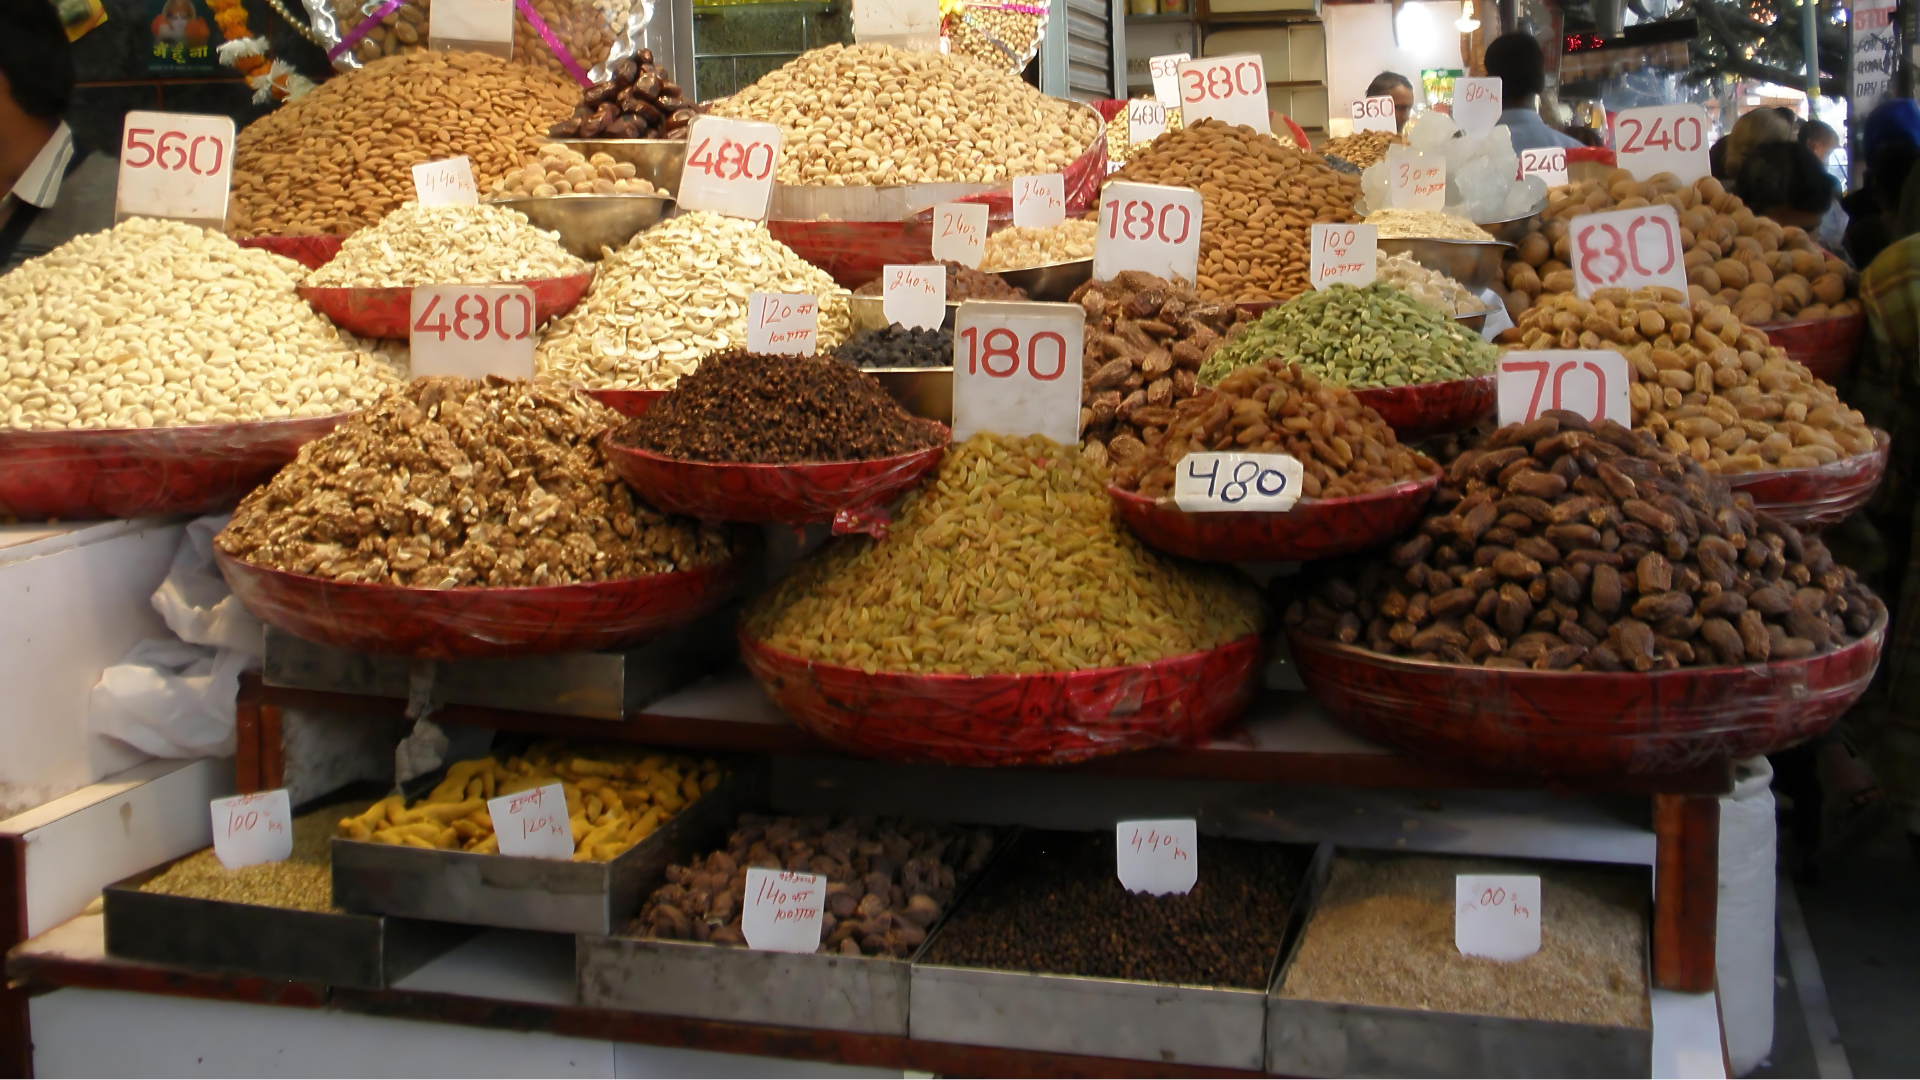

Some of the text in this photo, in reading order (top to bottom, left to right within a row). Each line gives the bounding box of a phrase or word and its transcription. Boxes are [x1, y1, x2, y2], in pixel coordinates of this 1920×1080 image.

[1151, 57, 1188, 78] 58
[1182, 62, 1263, 103] 380
[1131, 104, 1166, 126] 480
[1352, 98, 1394, 120] 360
[125, 128, 223, 176] 560
[1620, 117, 1702, 154] 240
[687, 137, 774, 181] 480
[1524, 153, 1567, 173] 240
[1106, 199, 1190, 245] 180
[1323, 228, 1355, 253] 100
[1577, 215, 1675, 285] 80
[413, 293, 530, 342] 480
[760, 296, 792, 330] 120
[960, 326, 1067, 382] 180
[1502, 361, 1606, 425] 70
[1189, 459, 1287, 504] 480
[756, 875, 787, 907] 140
